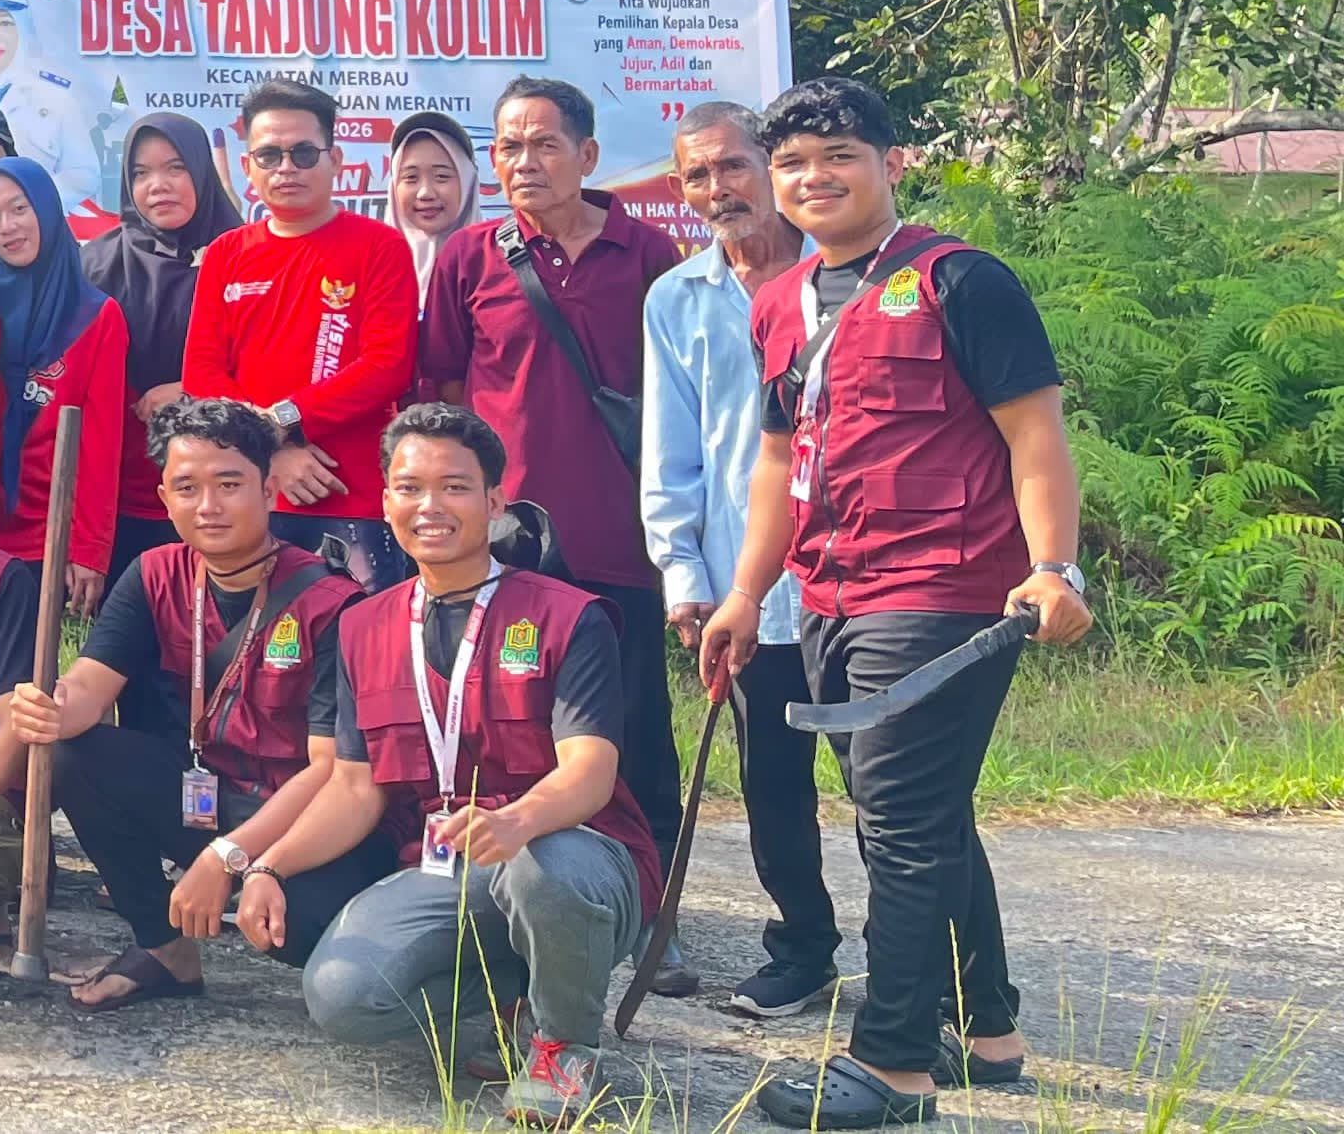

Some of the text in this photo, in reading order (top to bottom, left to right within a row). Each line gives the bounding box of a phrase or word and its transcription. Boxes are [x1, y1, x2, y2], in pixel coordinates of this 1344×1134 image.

[598, 15, 739, 32] Pemilihan Kepala Desa
[594, 38, 624, 53] yang
[626, 36, 666, 51] Aman,
[620, 56, 712, 73] Jujur, Adil dan
[207, 69, 409, 86] KECAMATAN MERBAU
[145, 92, 245, 108] KABUPATE
[385, 96, 471, 112] MERANTI
[646, 203, 676, 218] HAK
[682, 224, 711, 238] YAN
